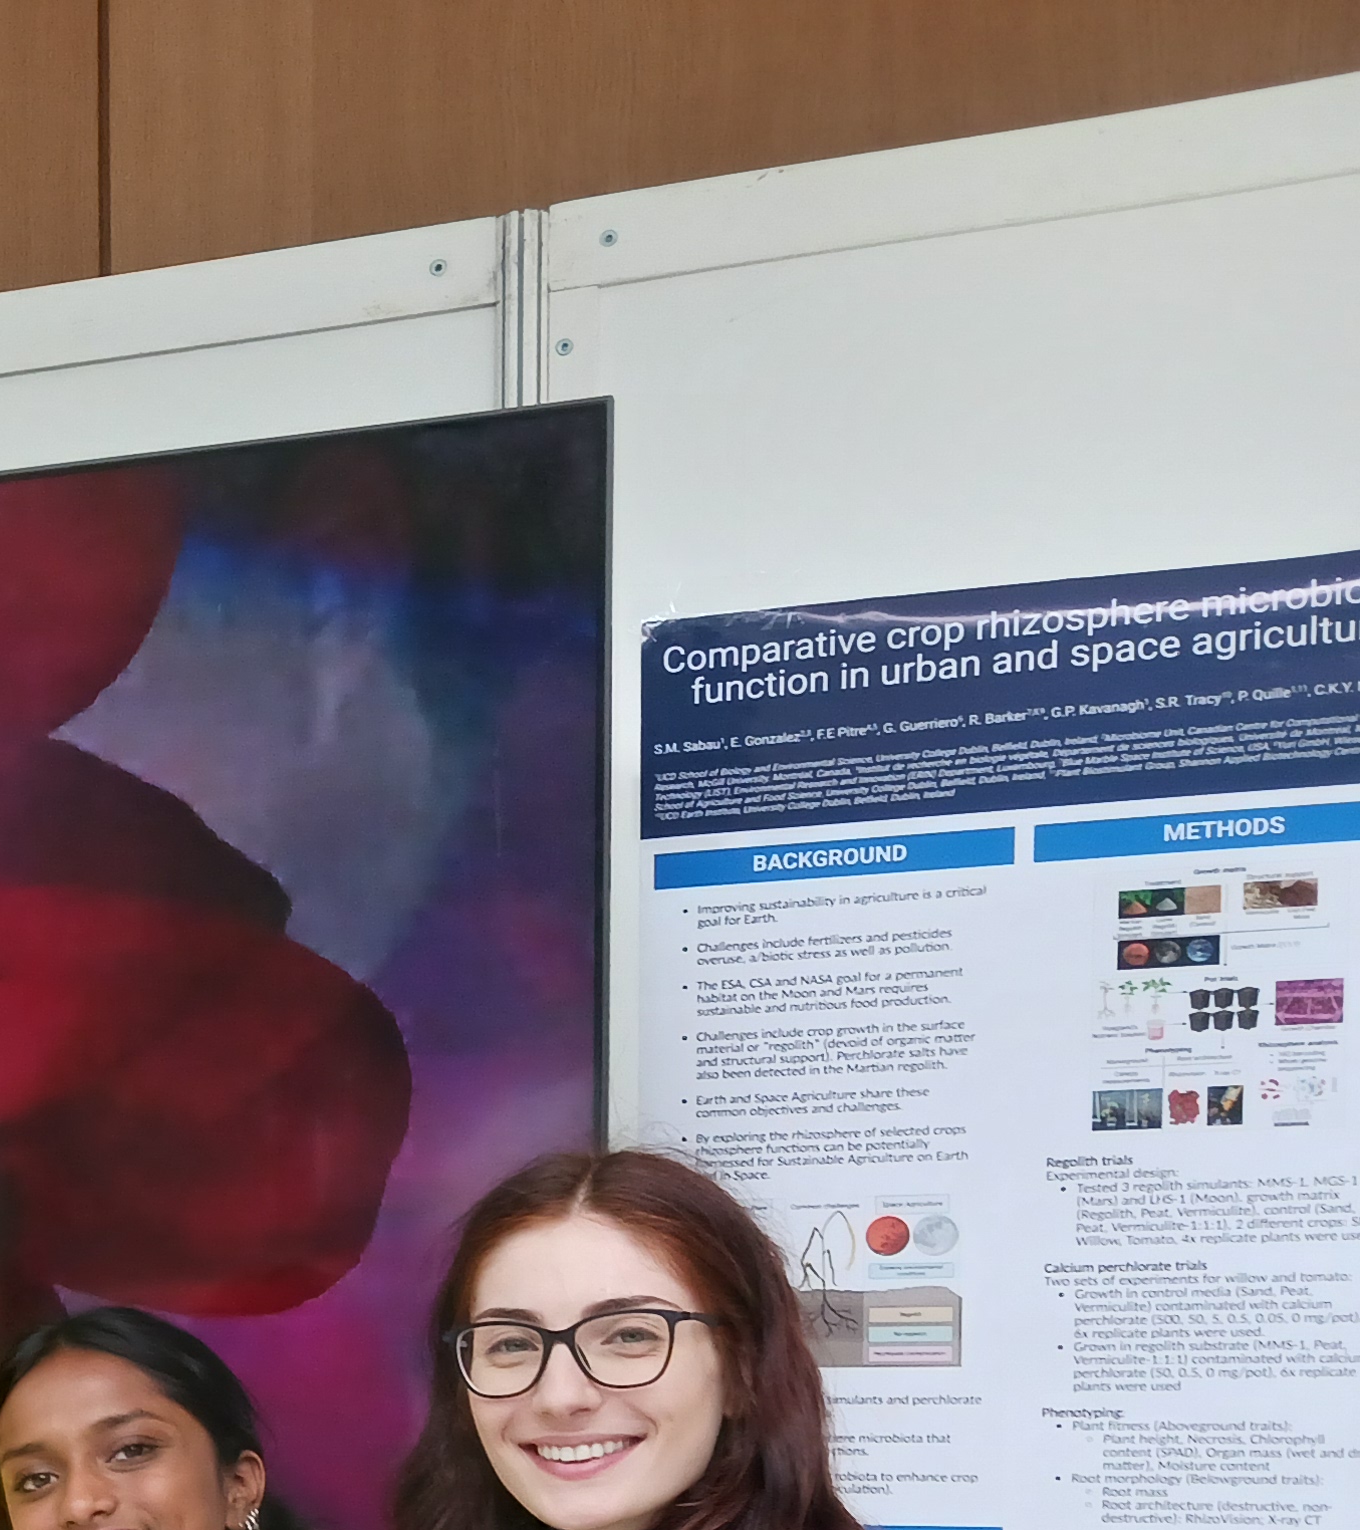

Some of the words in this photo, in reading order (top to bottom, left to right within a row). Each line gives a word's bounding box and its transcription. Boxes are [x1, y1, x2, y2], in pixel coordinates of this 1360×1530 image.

[663, 630, 876, 674] Comparative
[886, 621, 965, 651] crop
[976, 598, 1191, 641] rhizosphere
[1201, 577, 1360, 618] microbio
[691, 669, 829, 705] function
[840, 662, 869, 690] in
[881, 653, 980, 686] urban
[992, 640, 1058, 675] and
[1070, 635, 1181, 672] space
[1191, 615, 1360, 660] agricultu
[753, 844, 907, 872] BACKGROUND
[1164, 816, 1286, 842] METHODS
